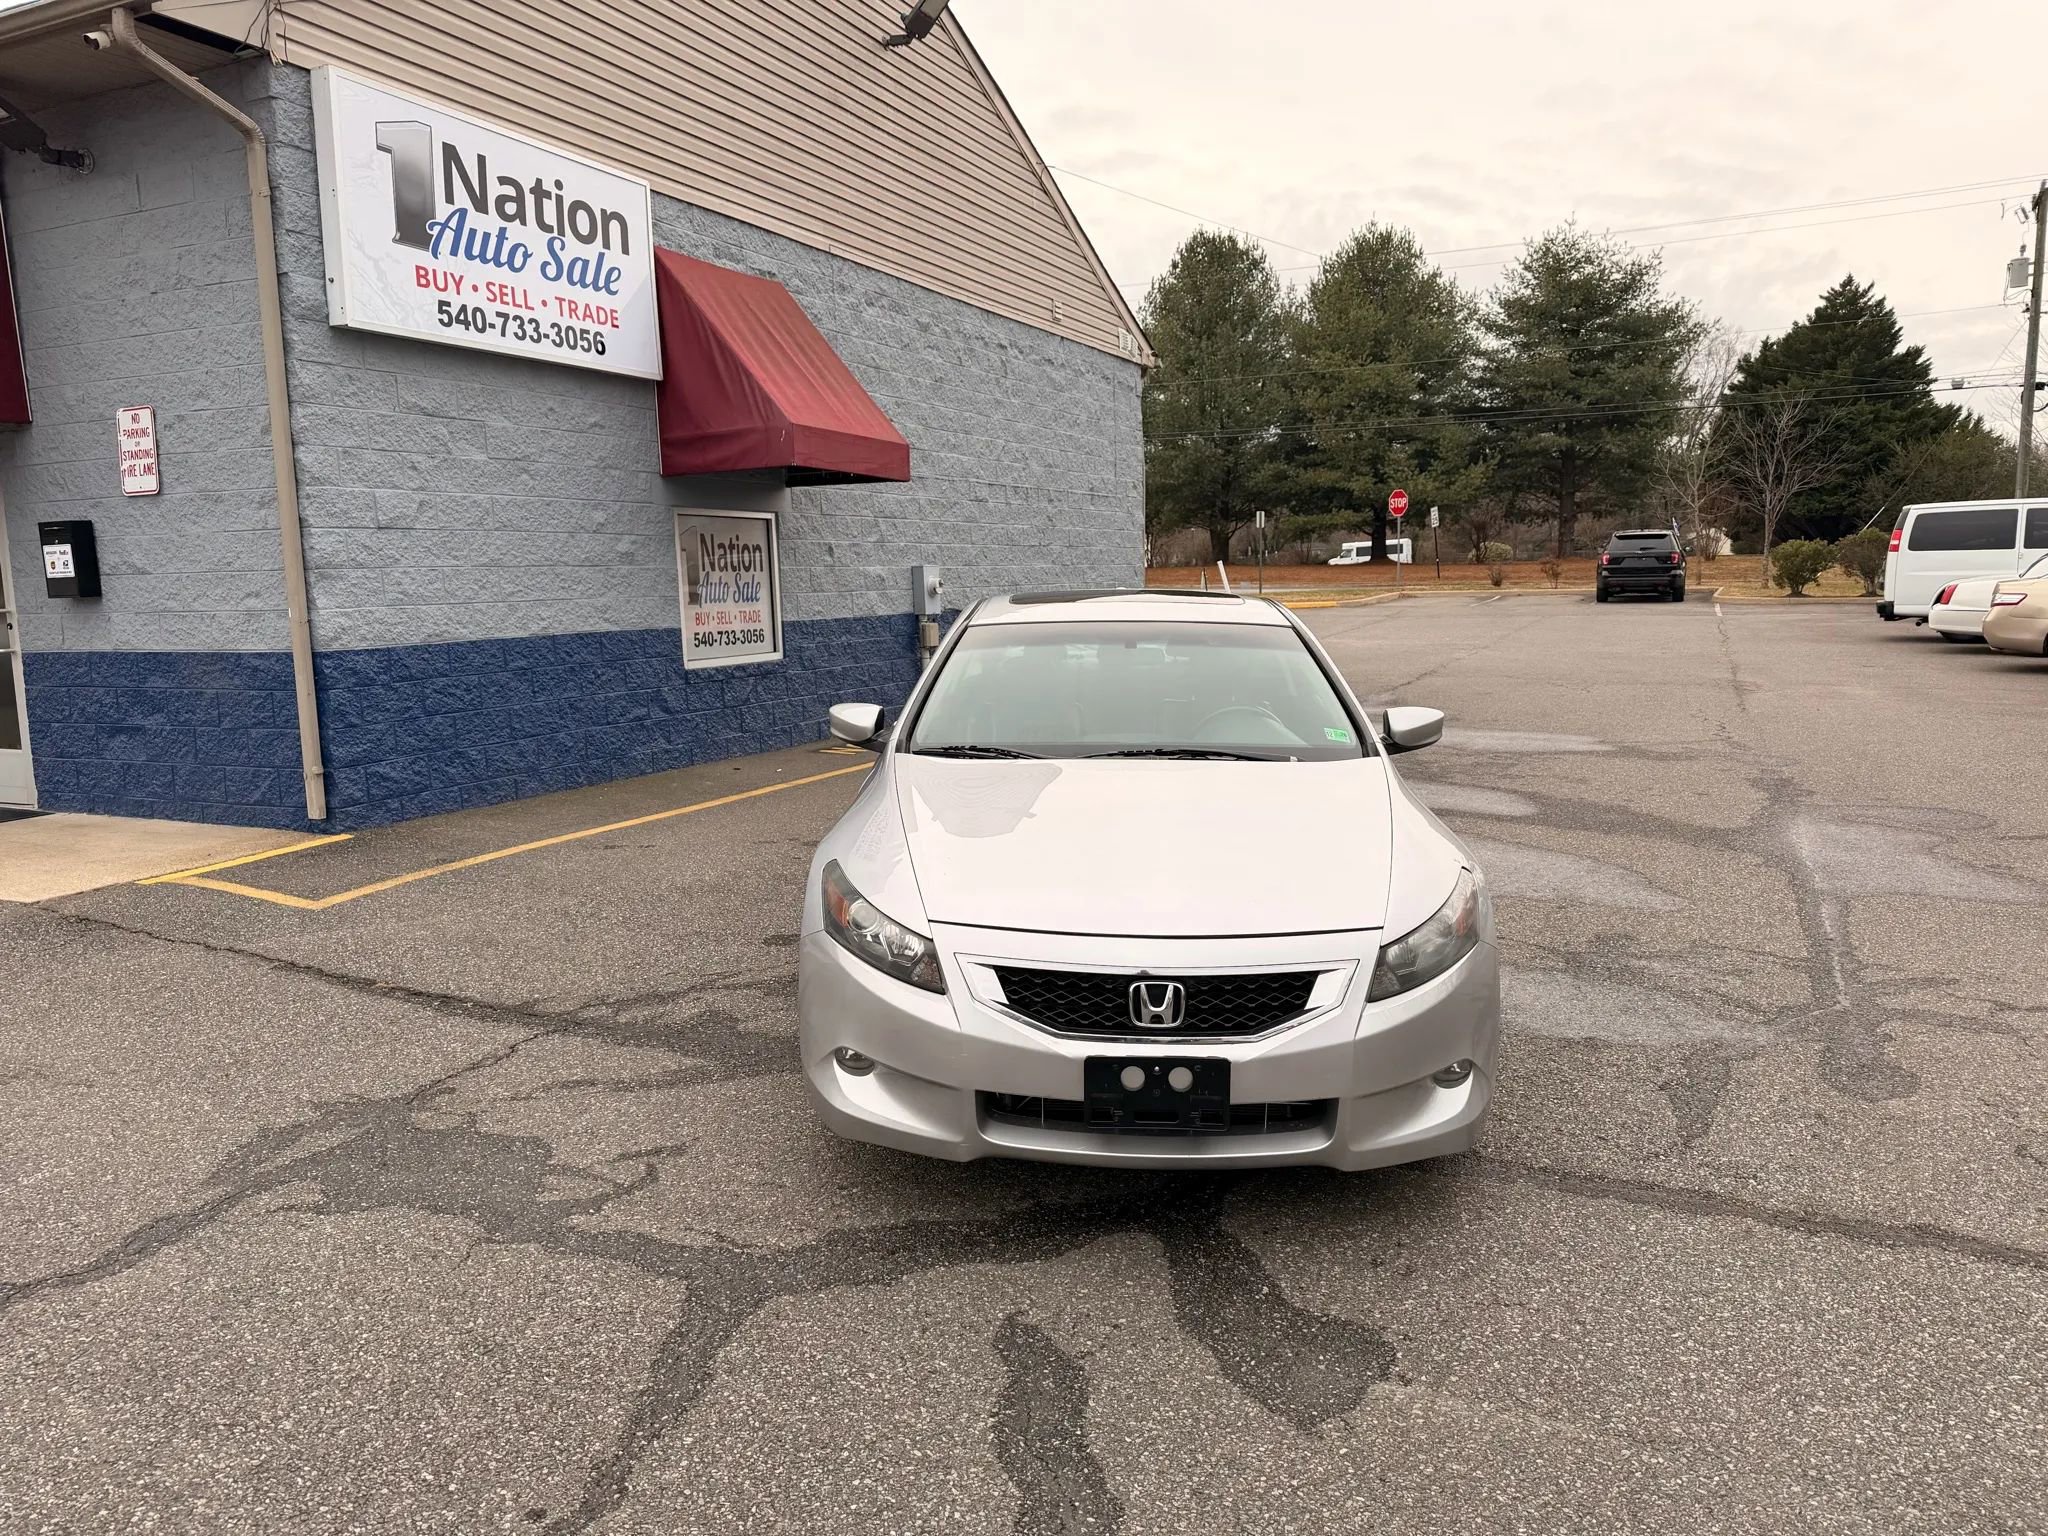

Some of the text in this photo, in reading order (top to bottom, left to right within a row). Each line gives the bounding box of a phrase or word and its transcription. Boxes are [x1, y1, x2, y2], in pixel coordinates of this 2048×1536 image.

[441, 141, 630, 256] Nation
[427, 207, 622, 296] Auto Sale
[414, 264, 620, 329] BUY SELL TRADE
[437, 299, 606, 356] 540-733-3056
[131, 413, 140, 424] NO
[123, 427, 150, 439] PARKING
[123, 448, 153, 461] STANDING
[139, 462, 155, 476] LANE
[1390, 498, 1406, 508] STOP
[700, 533, 763, 572] Nation
[697, 571, 761, 608] Auto Sale
[695, 610, 761, 626] BUY SELL TRADE
[694, 629, 764, 648] 540-733-3056
